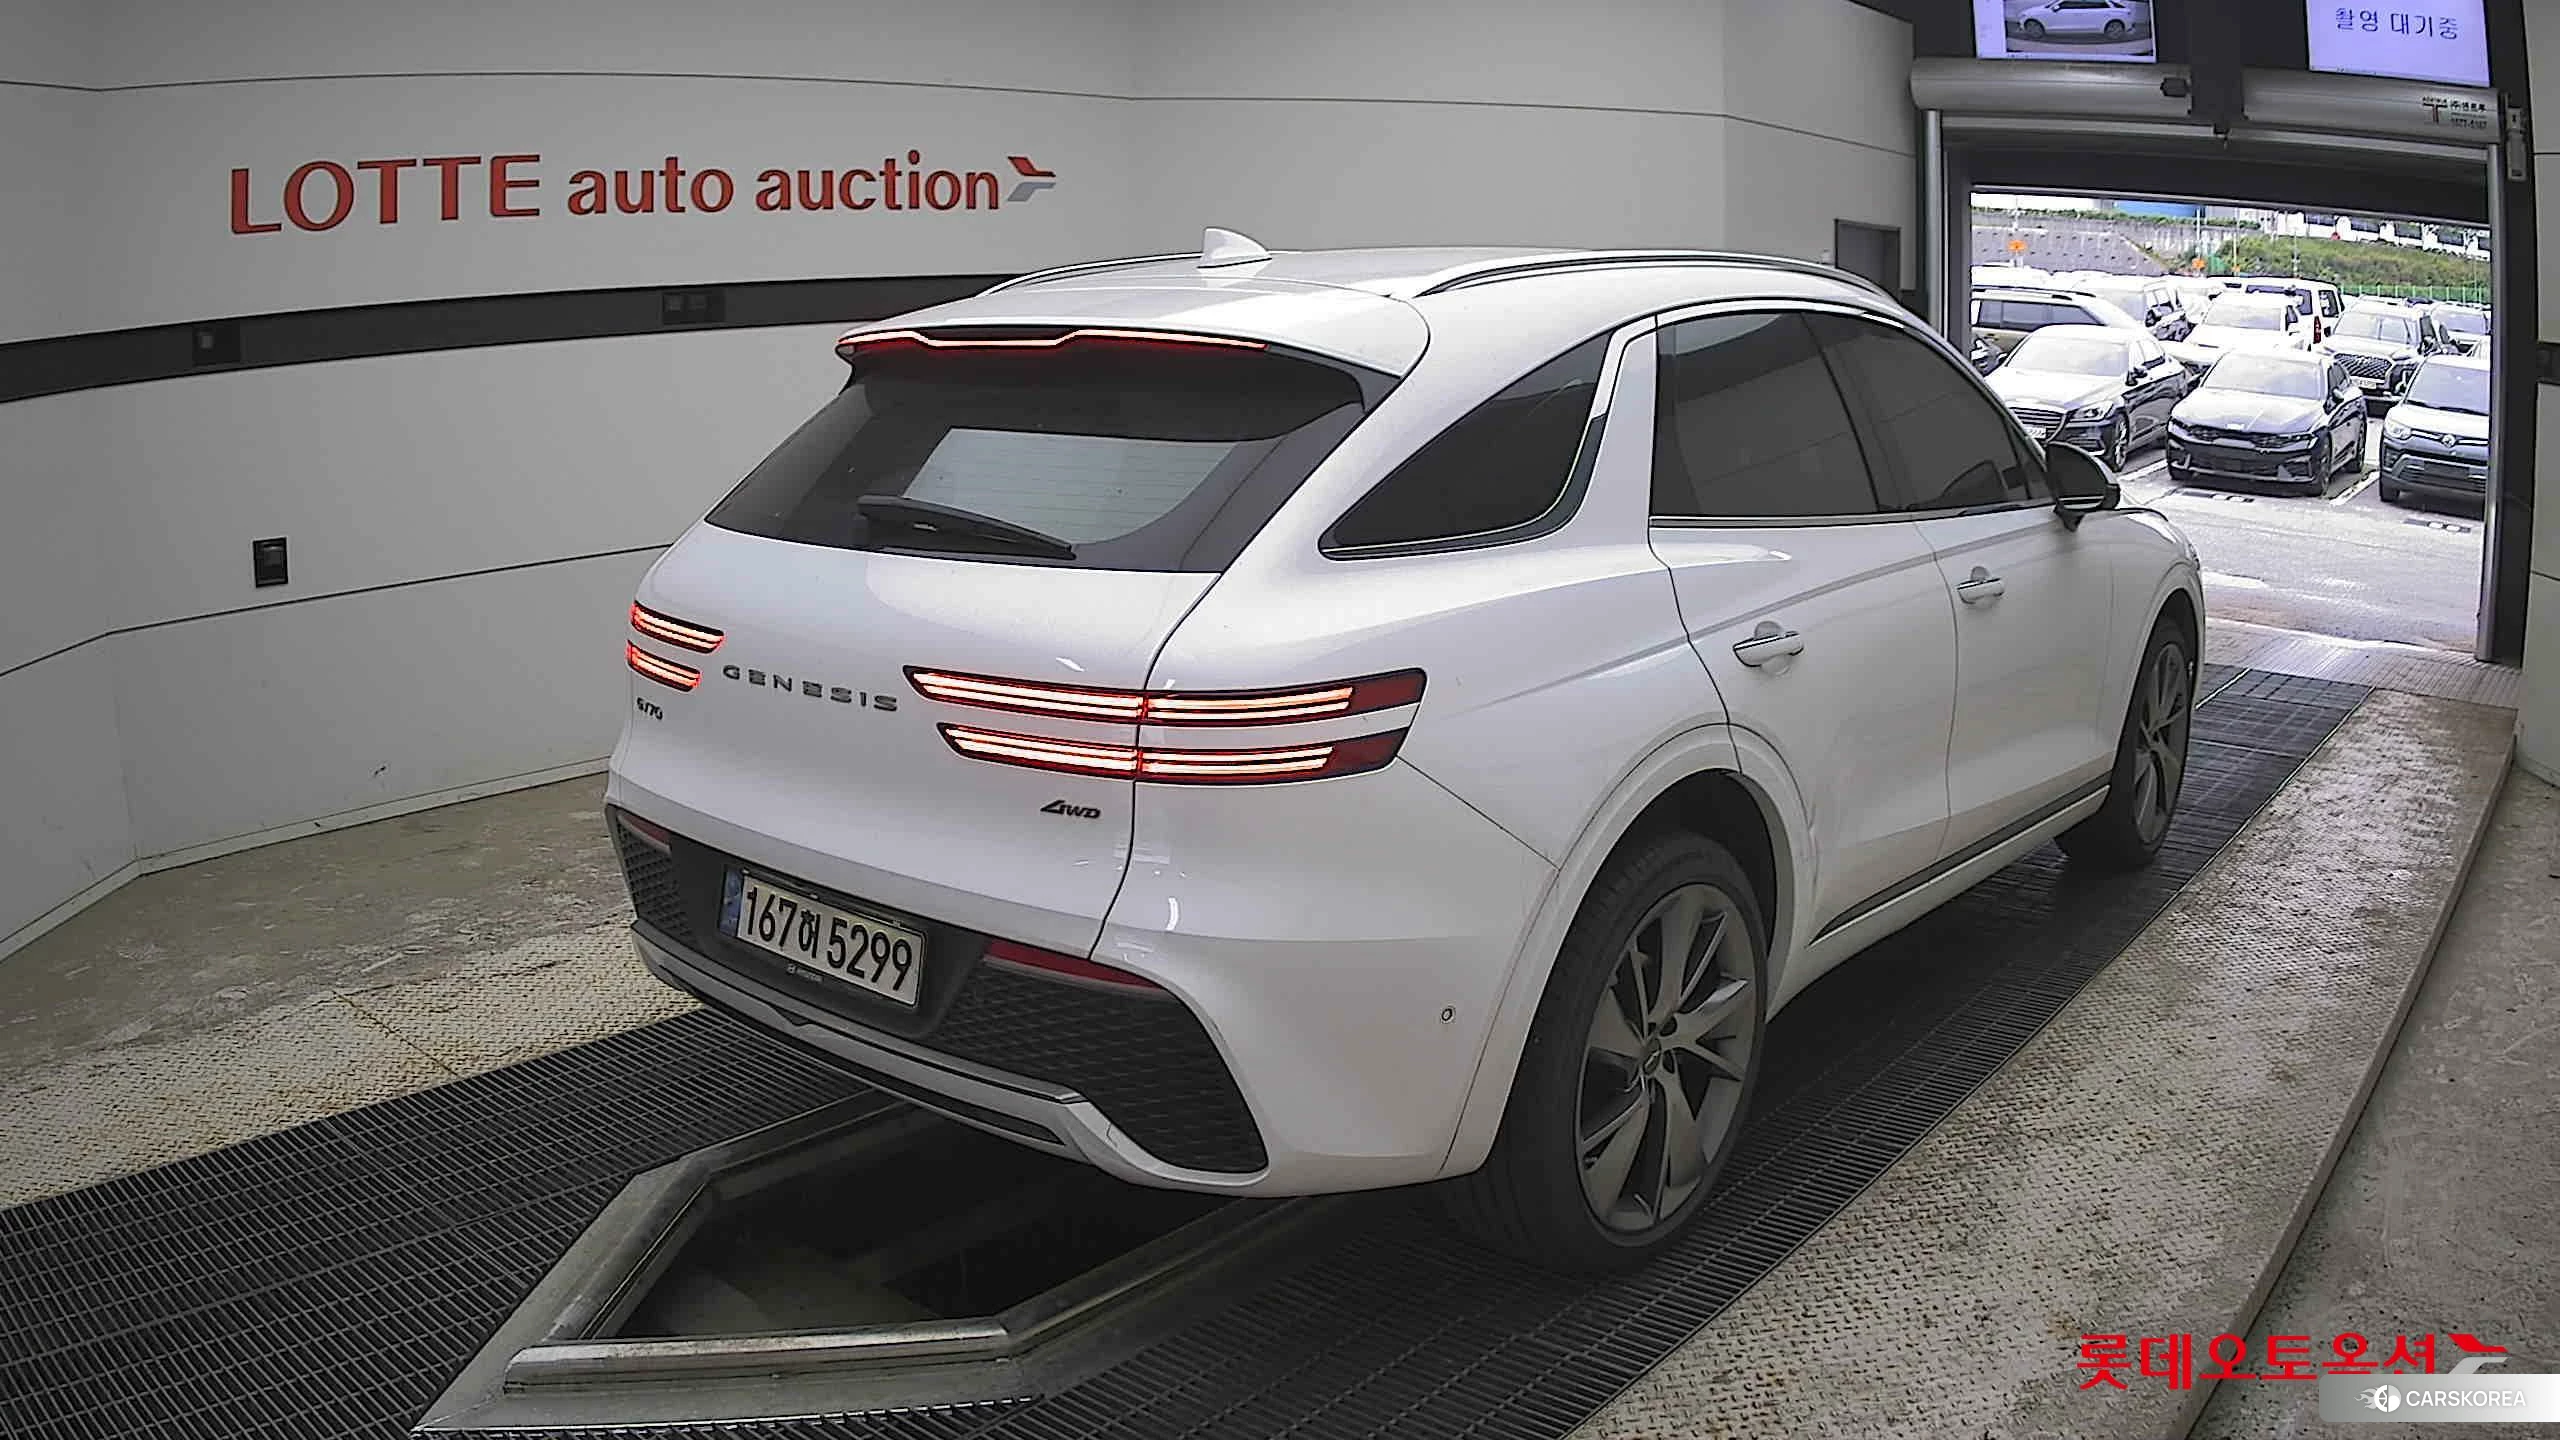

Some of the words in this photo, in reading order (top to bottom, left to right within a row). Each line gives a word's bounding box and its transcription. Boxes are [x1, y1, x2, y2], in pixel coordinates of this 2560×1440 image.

[2335, 7, 2379, 32] 촬영
[2389, 13, 2458, 40] 대기중
[230, 153, 541, 235] LOTTE
[567, 156, 736, 216] auto
[754, 149, 1001, 211] auction
[722, 664, 898, 712] GENESIS
[746, 886, 821, 959] 167허
[826, 916, 913, 992] 5299
